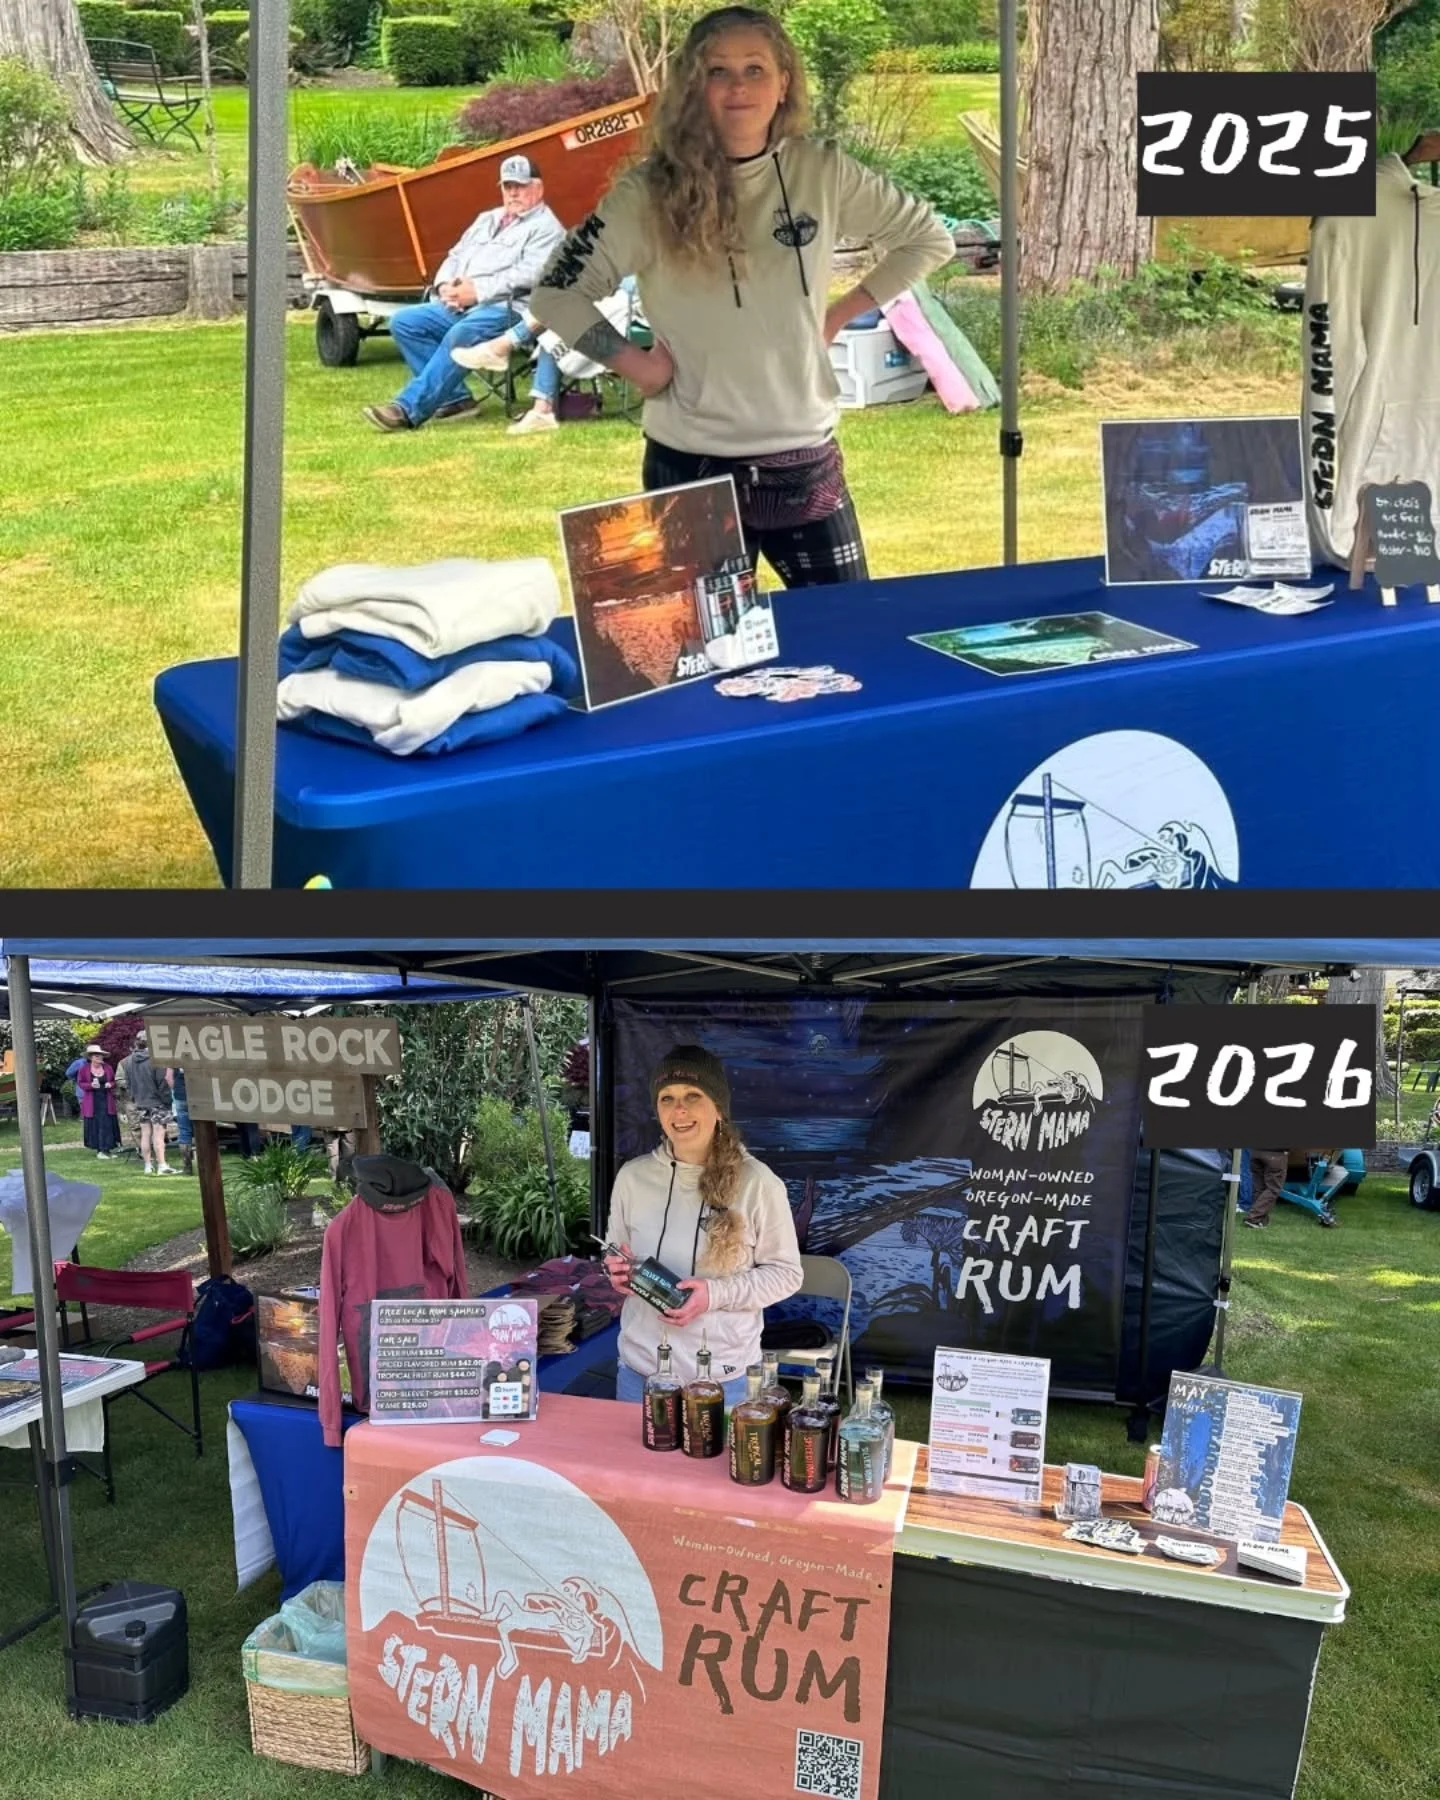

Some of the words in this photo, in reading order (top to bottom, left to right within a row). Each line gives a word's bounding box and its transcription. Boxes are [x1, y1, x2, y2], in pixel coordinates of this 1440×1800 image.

[1308, 302, 1334, 396] MAMA
[1311, 411, 1336, 510] STERN
[150, 1025, 267, 1061] EAGLE
[281, 1026, 393, 1066] ROCK
[212, 1078, 335, 1116] LODGE
[980, 1108, 1032, 1152] STERN
[1037, 1111, 1090, 1152] MAMA
[969, 1168, 1094, 1186] WOMAN-OWNED
[966, 1190, 1092, 1211] OREGON-MADE
[962, 1214, 1090, 1256] CRAFT
[955, 1256, 1081, 1314] RUM
[379, 1308, 400, 1316] FREE
[403, 1308, 426, 1318] LOCAL
[449, 1307, 485, 1317] SAMPLES
[379, 1336, 395, 1345] FOR
[404, 1360, 439, 1368] FLAVORED
[1171, 1402, 1205, 1413] EVENTS
[1173, 1384, 1208, 1403] MAY
[672, 1535, 774, 1566] Woman-Owned,
[779, 1553, 873, 1580] Oregon-Made
[678, 1570, 871, 1642] CRAFT
[678, 1623, 861, 1723] RUM
[378, 1633, 495, 1764] STERN
[509, 1674, 632, 1777] MAMA
